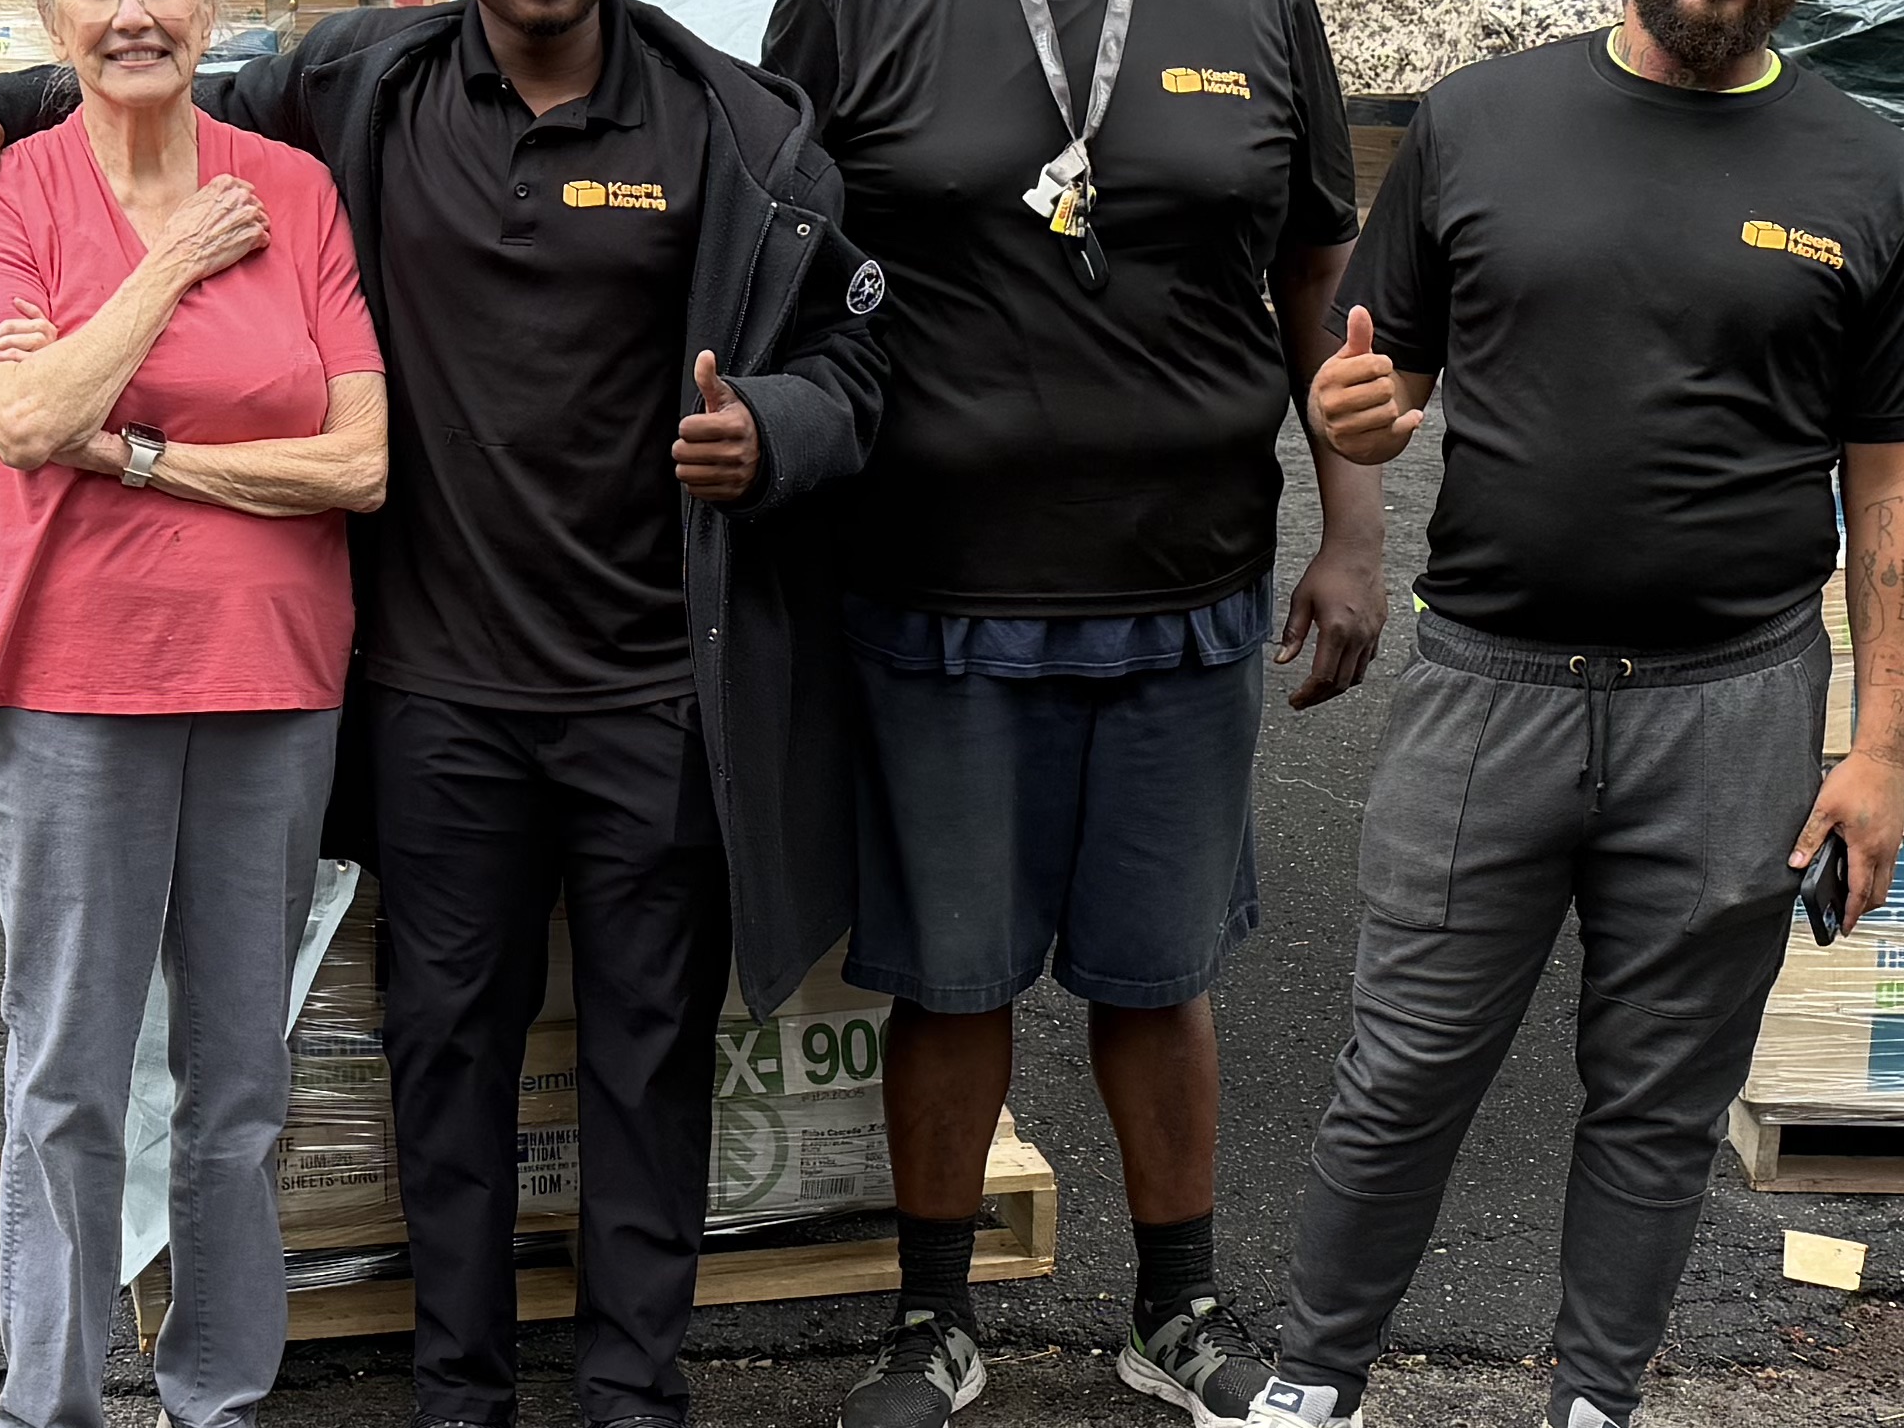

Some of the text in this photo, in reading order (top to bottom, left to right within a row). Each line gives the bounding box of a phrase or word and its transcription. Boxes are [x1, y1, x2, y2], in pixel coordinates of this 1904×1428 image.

[1203, 80, 1251, 100] Moving
[609, 194, 667, 211] Moving
[1787, 239, 1844, 269] Moving
[531, 1145, 562, 1162] TIDAL
